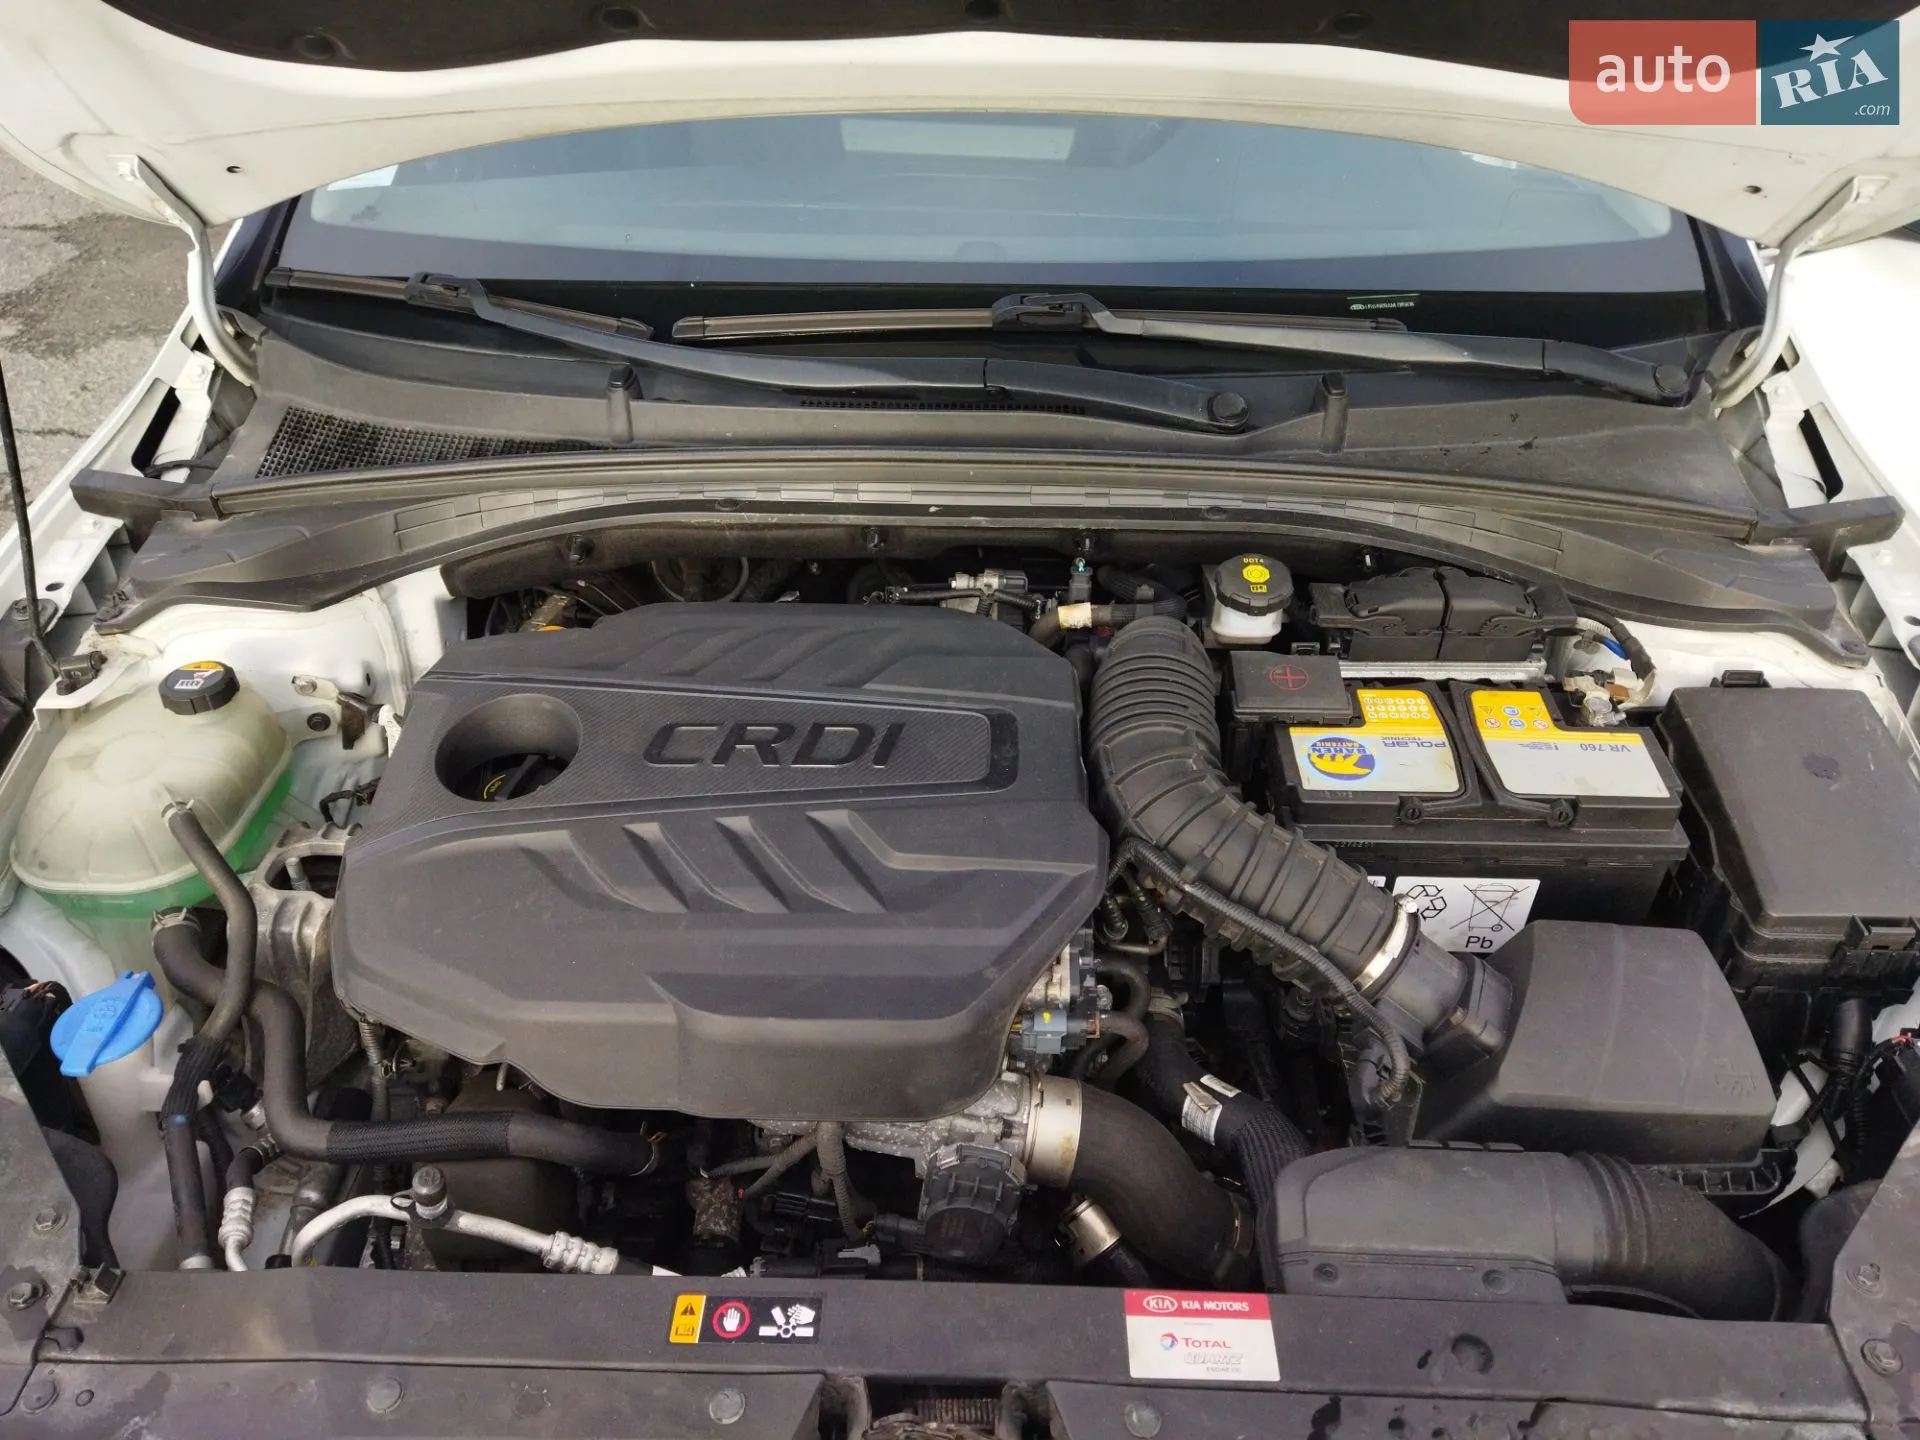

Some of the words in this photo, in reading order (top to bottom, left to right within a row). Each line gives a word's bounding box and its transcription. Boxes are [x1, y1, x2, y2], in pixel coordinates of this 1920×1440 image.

[642, 722, 906, 769] CRDI
[1579, 743, 1605, 752] 760
[1608, 744, 1631, 753] VR
[1465, 935, 1493, 949] Pb
[1149, 1299, 1172, 1310] KIA
[1181, 1300, 1201, 1310] KIA
[1203, 1301, 1250, 1312] MOTORS
[1182, 1337, 1232, 1349] TOTAL
